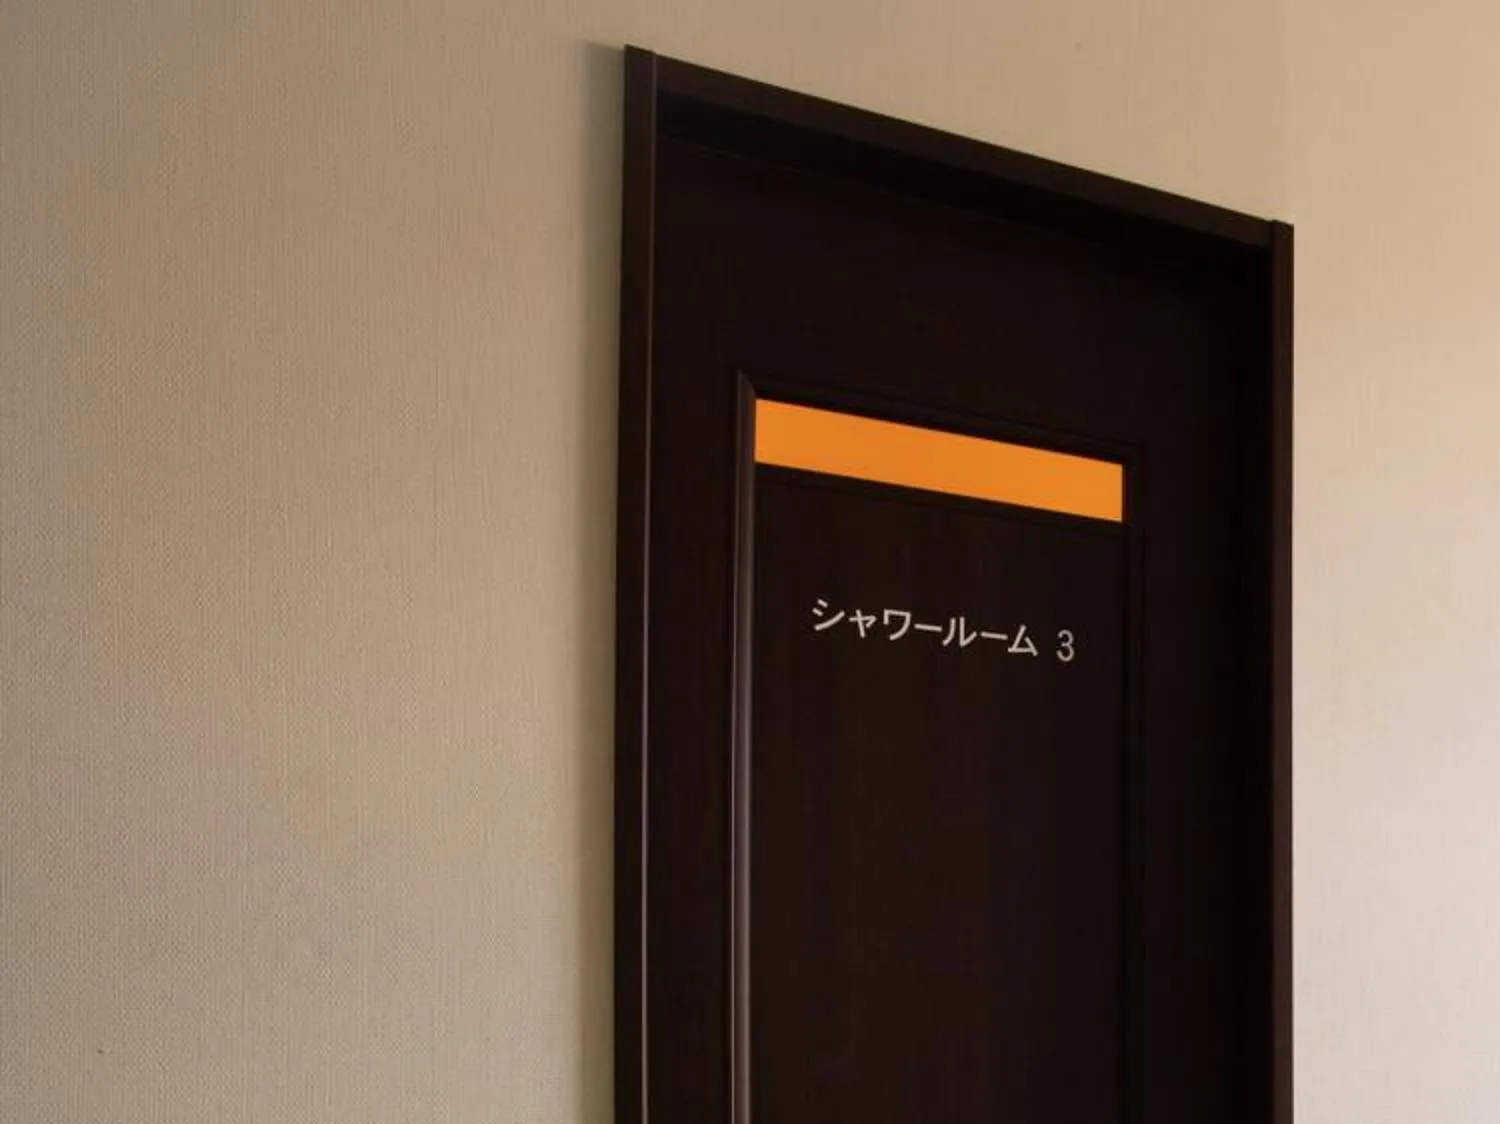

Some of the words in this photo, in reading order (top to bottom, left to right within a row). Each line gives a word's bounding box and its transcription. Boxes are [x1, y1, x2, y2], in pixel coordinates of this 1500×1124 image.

[812, 599, 1038, 657] シャワールーム
[1056, 629, 1075, 663] 3
